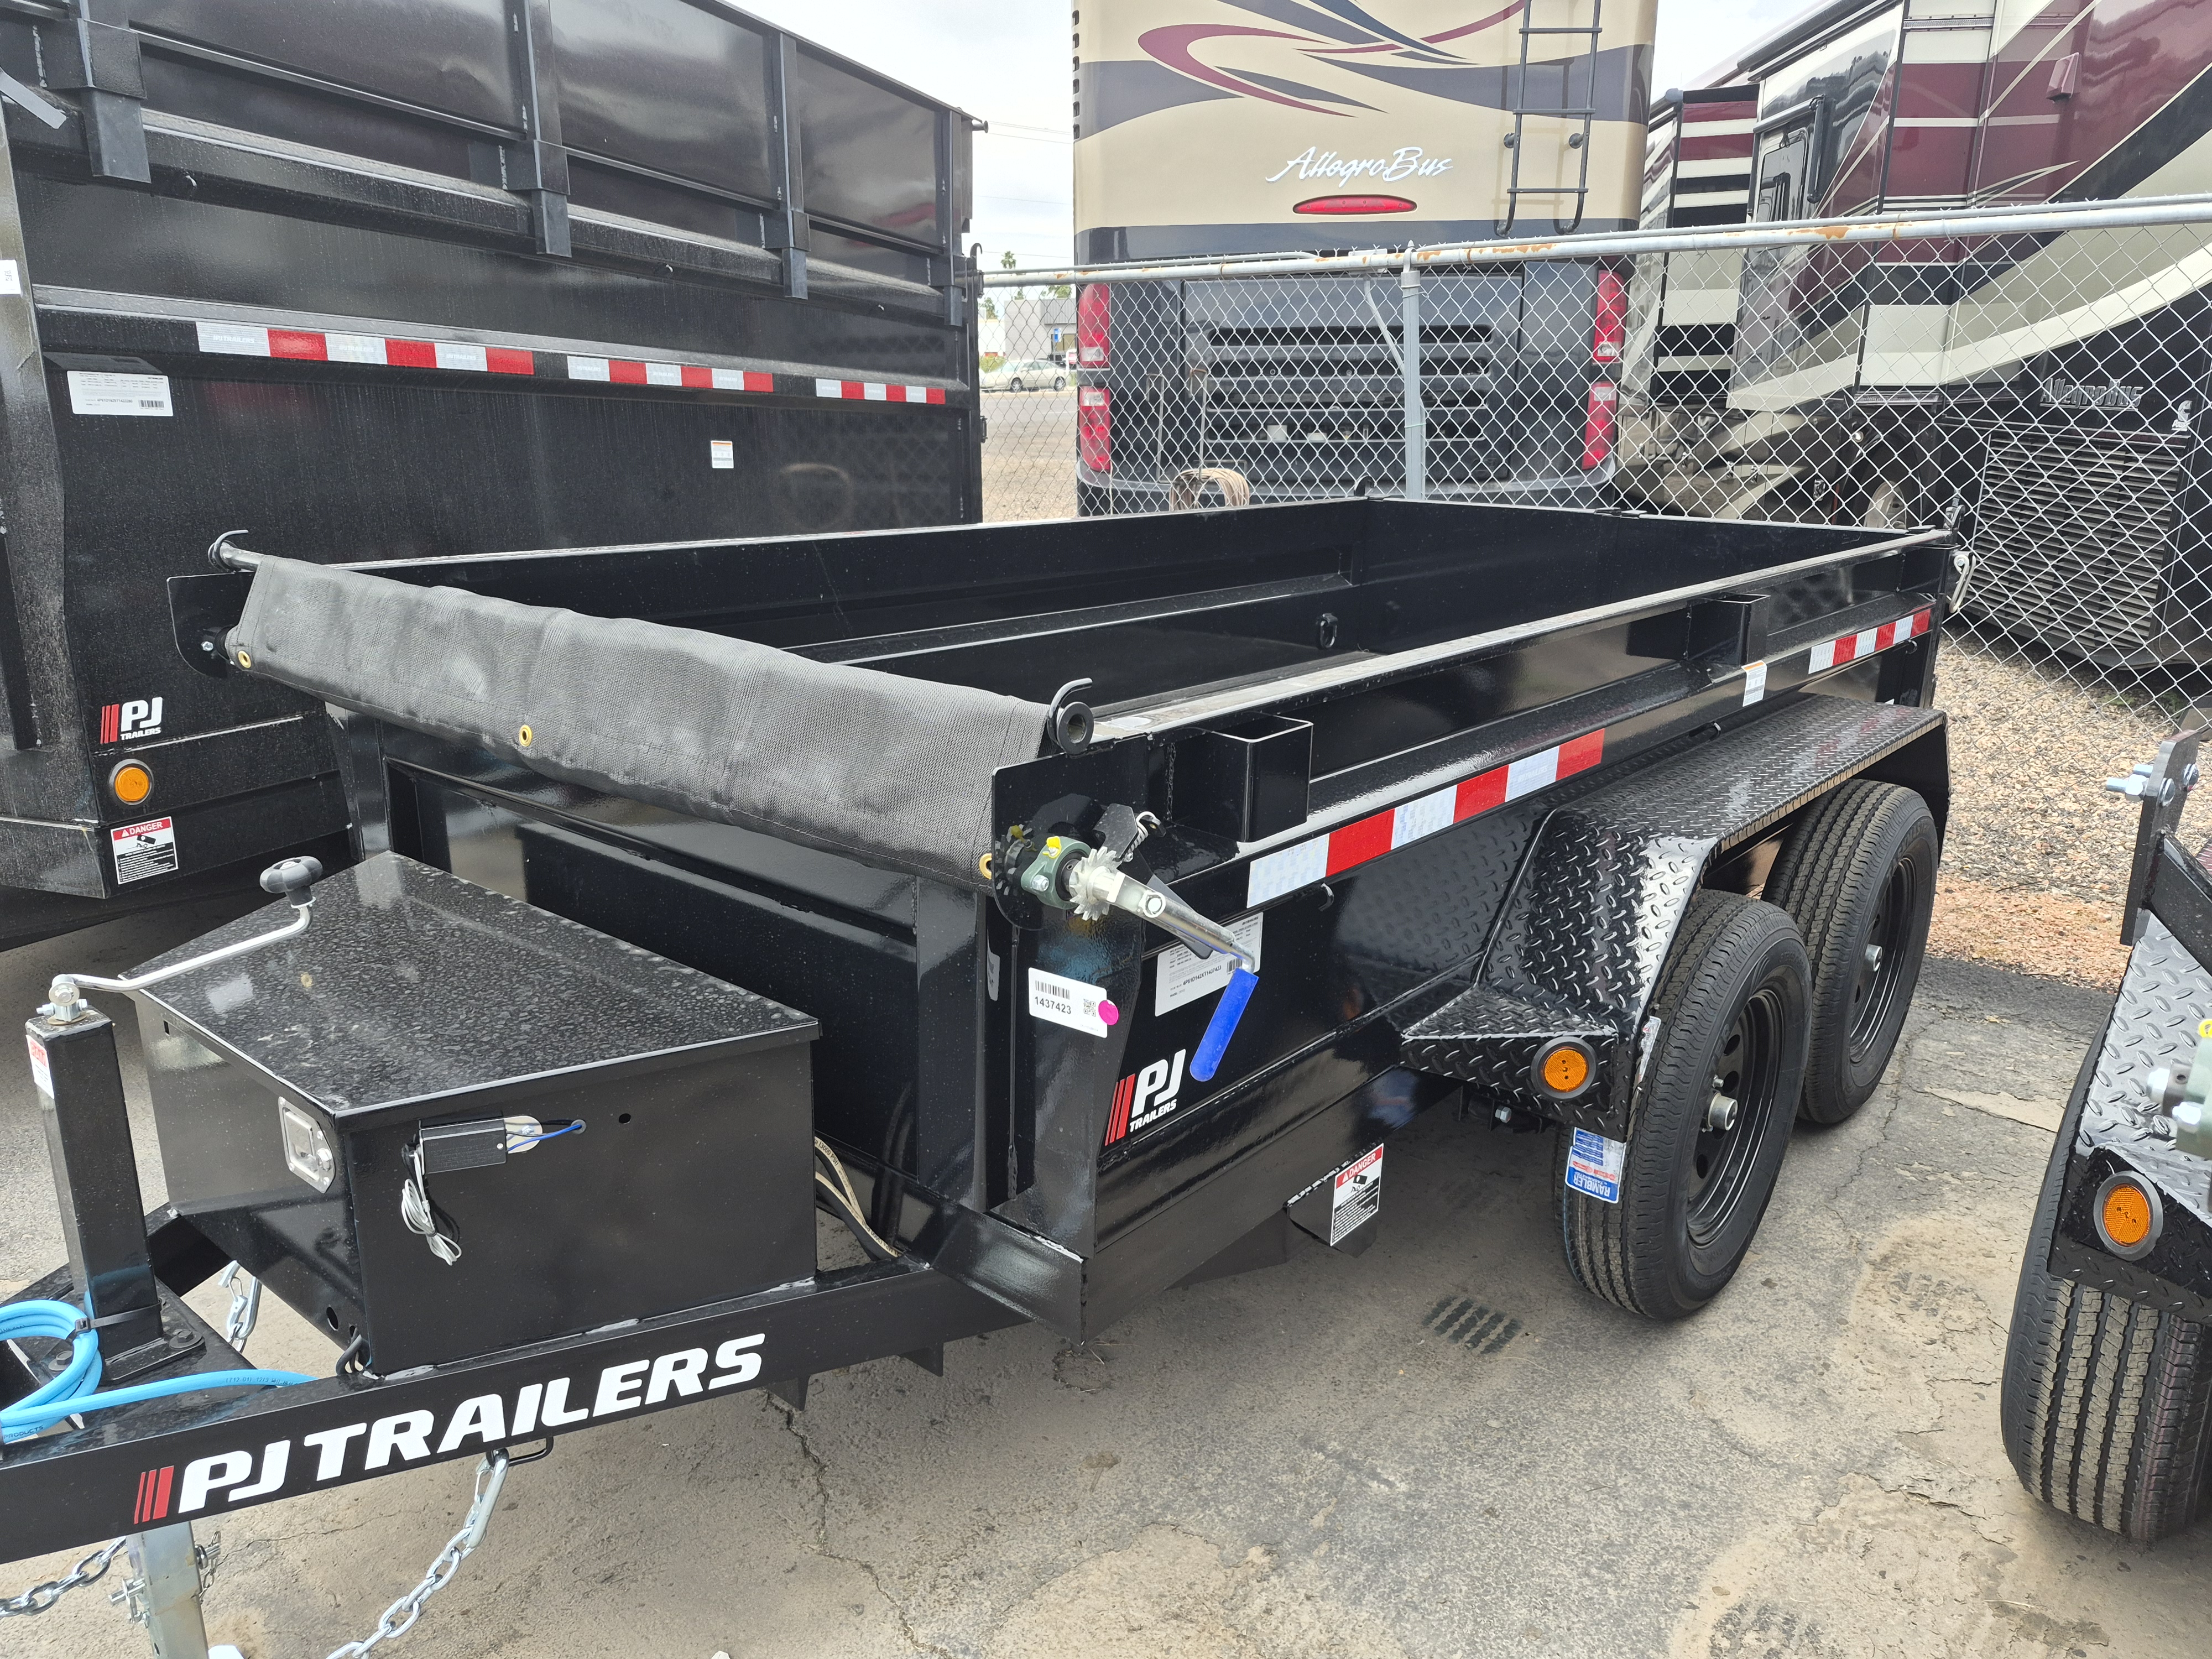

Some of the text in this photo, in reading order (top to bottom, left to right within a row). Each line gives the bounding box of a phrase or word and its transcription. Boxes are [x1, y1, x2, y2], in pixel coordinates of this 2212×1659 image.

[1382, 146, 1454, 183] Bus
[121, 696, 163, 732] PJ
[120, 727, 161, 740] TRAILERS
[129, 821, 164, 836] DANGER
[1035, 996, 1072, 1014] 1437423
[1131, 1048, 1186, 1119] PJ
[1129, 1098, 1177, 1133] TRAILERS
[1349, 1152, 1376, 1177] DANGER
[1573, 1174, 1611, 1197] RAMBLER
[3, 1425, 44, 1439] PRODUCTS
[179, 1332, 766, 1514] PJ TRAILERS
